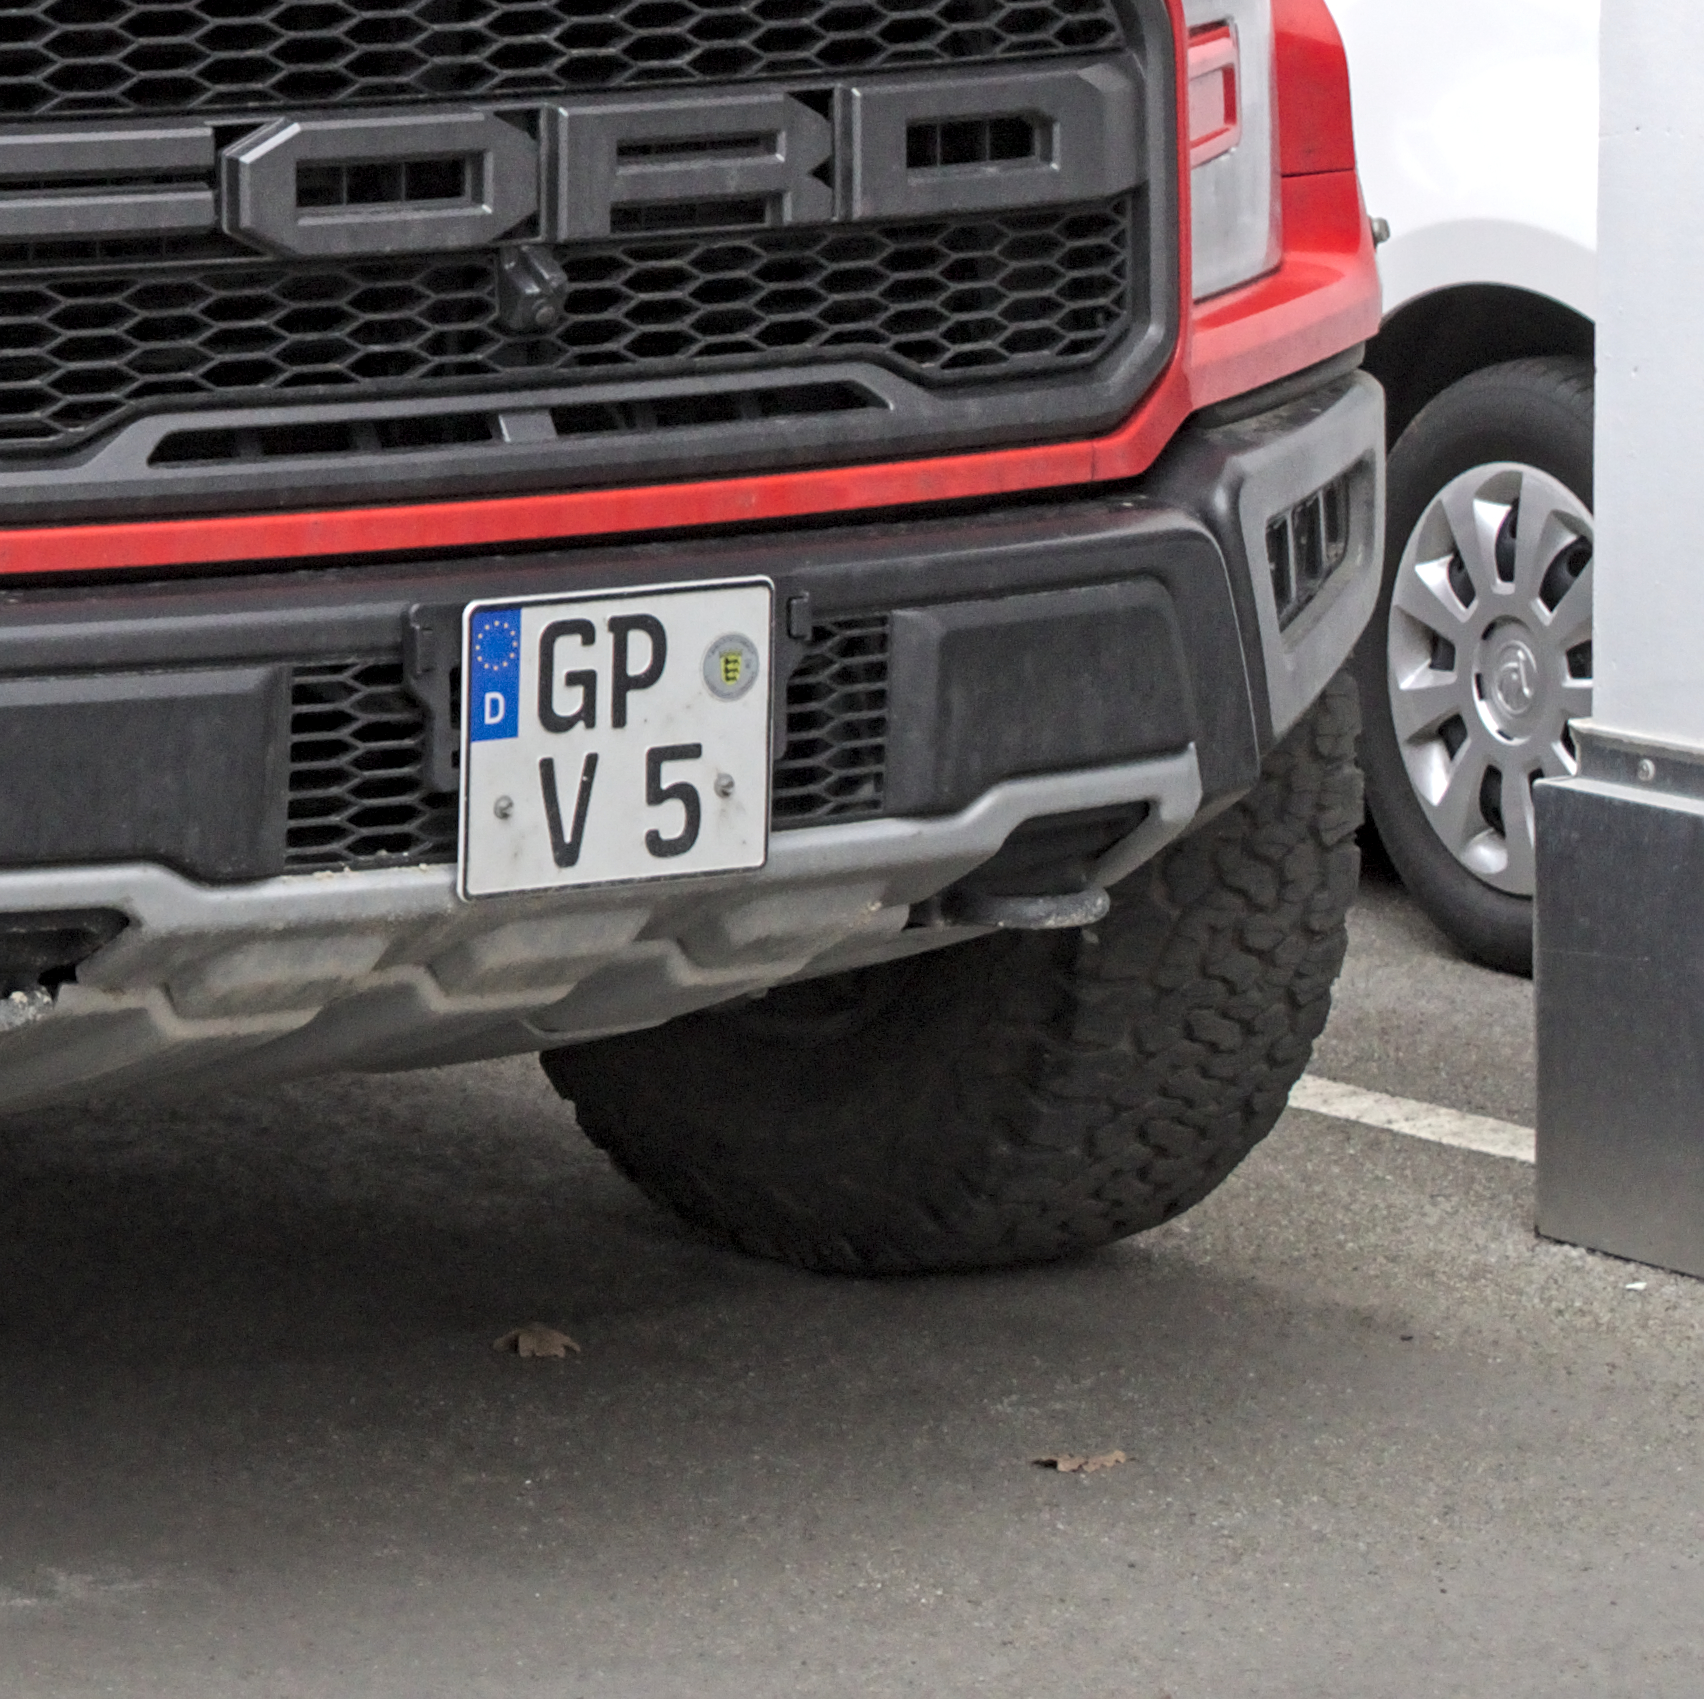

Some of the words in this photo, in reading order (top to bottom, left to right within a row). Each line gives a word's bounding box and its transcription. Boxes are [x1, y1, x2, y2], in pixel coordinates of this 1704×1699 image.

[484, 691, 505, 726] D
[537, 613, 668, 733] GP
[538, 751, 599, 868] V
[644, 742, 702, 858] 5
